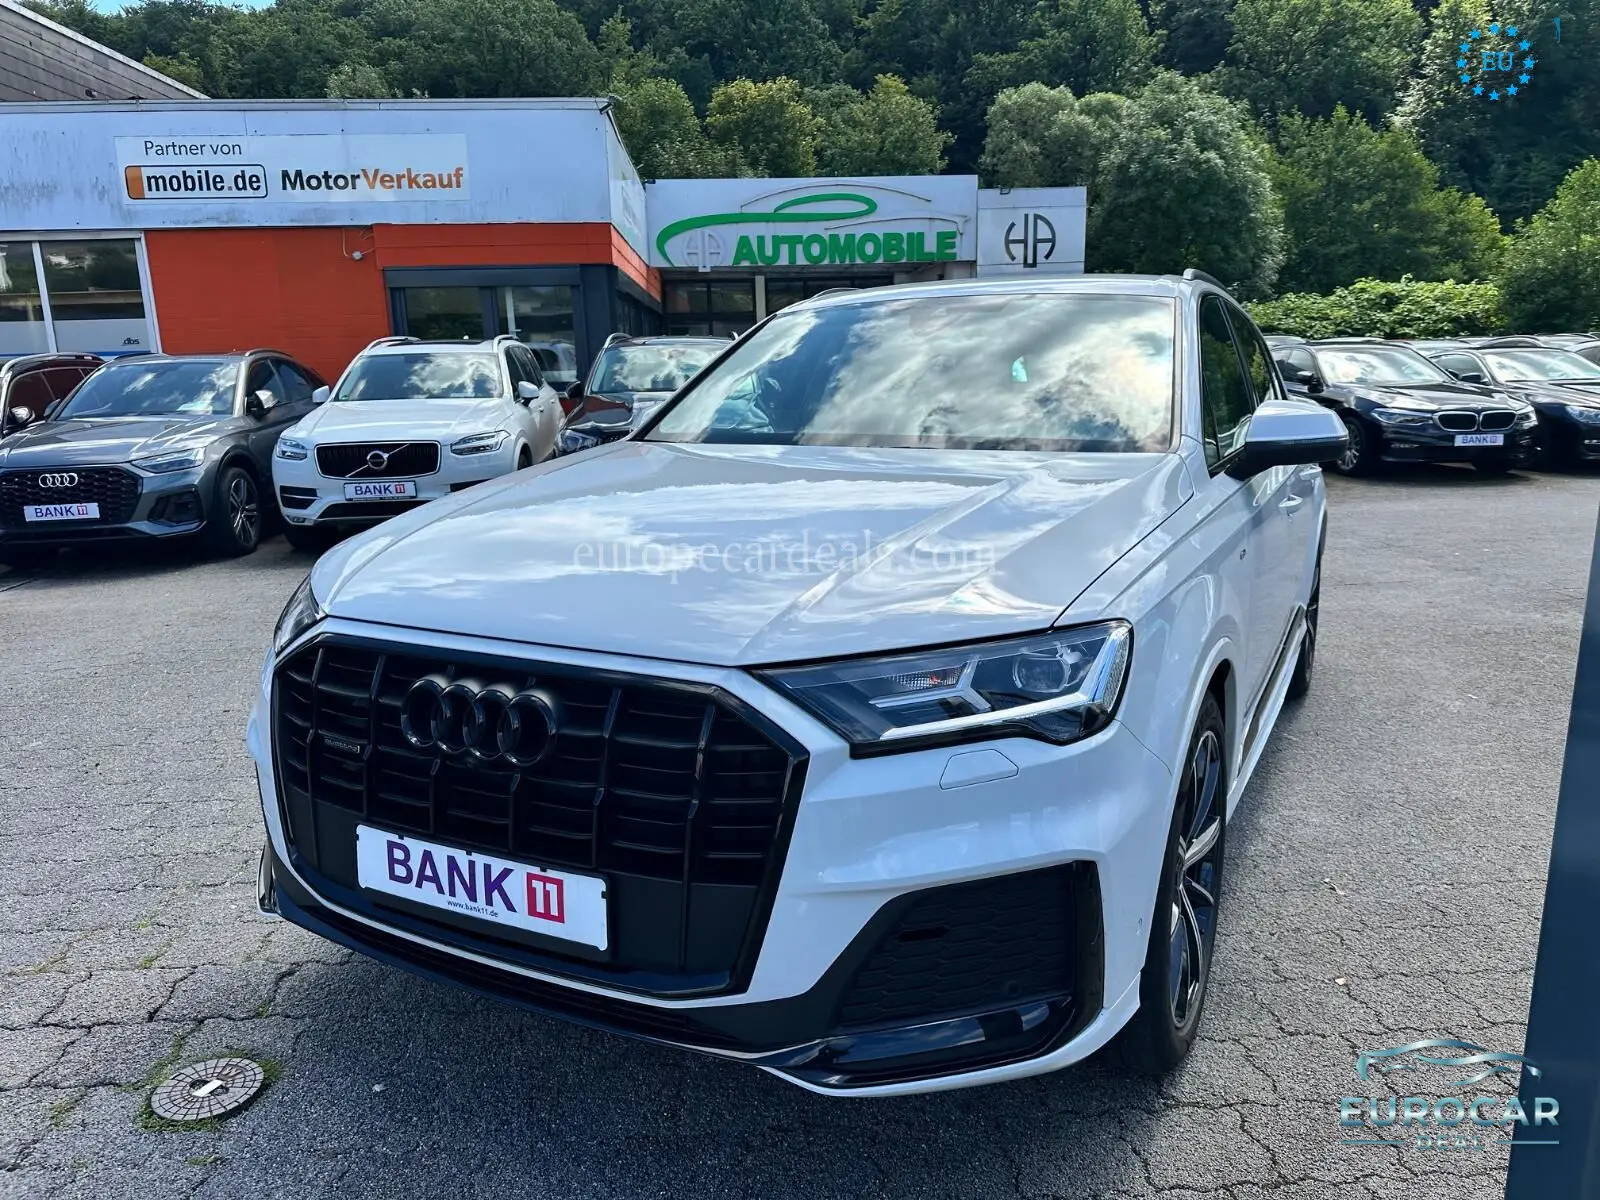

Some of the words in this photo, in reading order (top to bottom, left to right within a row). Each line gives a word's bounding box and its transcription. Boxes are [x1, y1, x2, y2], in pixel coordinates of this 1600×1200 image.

[144, 140, 206, 155] Partner
[210, 144, 242, 155] von
[146, 169, 261, 192] mobile.de
[281, 167, 464, 191] MotorVerkauf
[732, 230, 958, 266] AUTOMOBILE
[1461, 435, 1489, 444] BANK
[354, 484, 393, 495] BANK
[34, 506, 75, 518] BANK
[386, 839, 518, 913] BANK
[529, 876, 561, 919] 11
[447, 899, 499, 918] www.bank11.de
